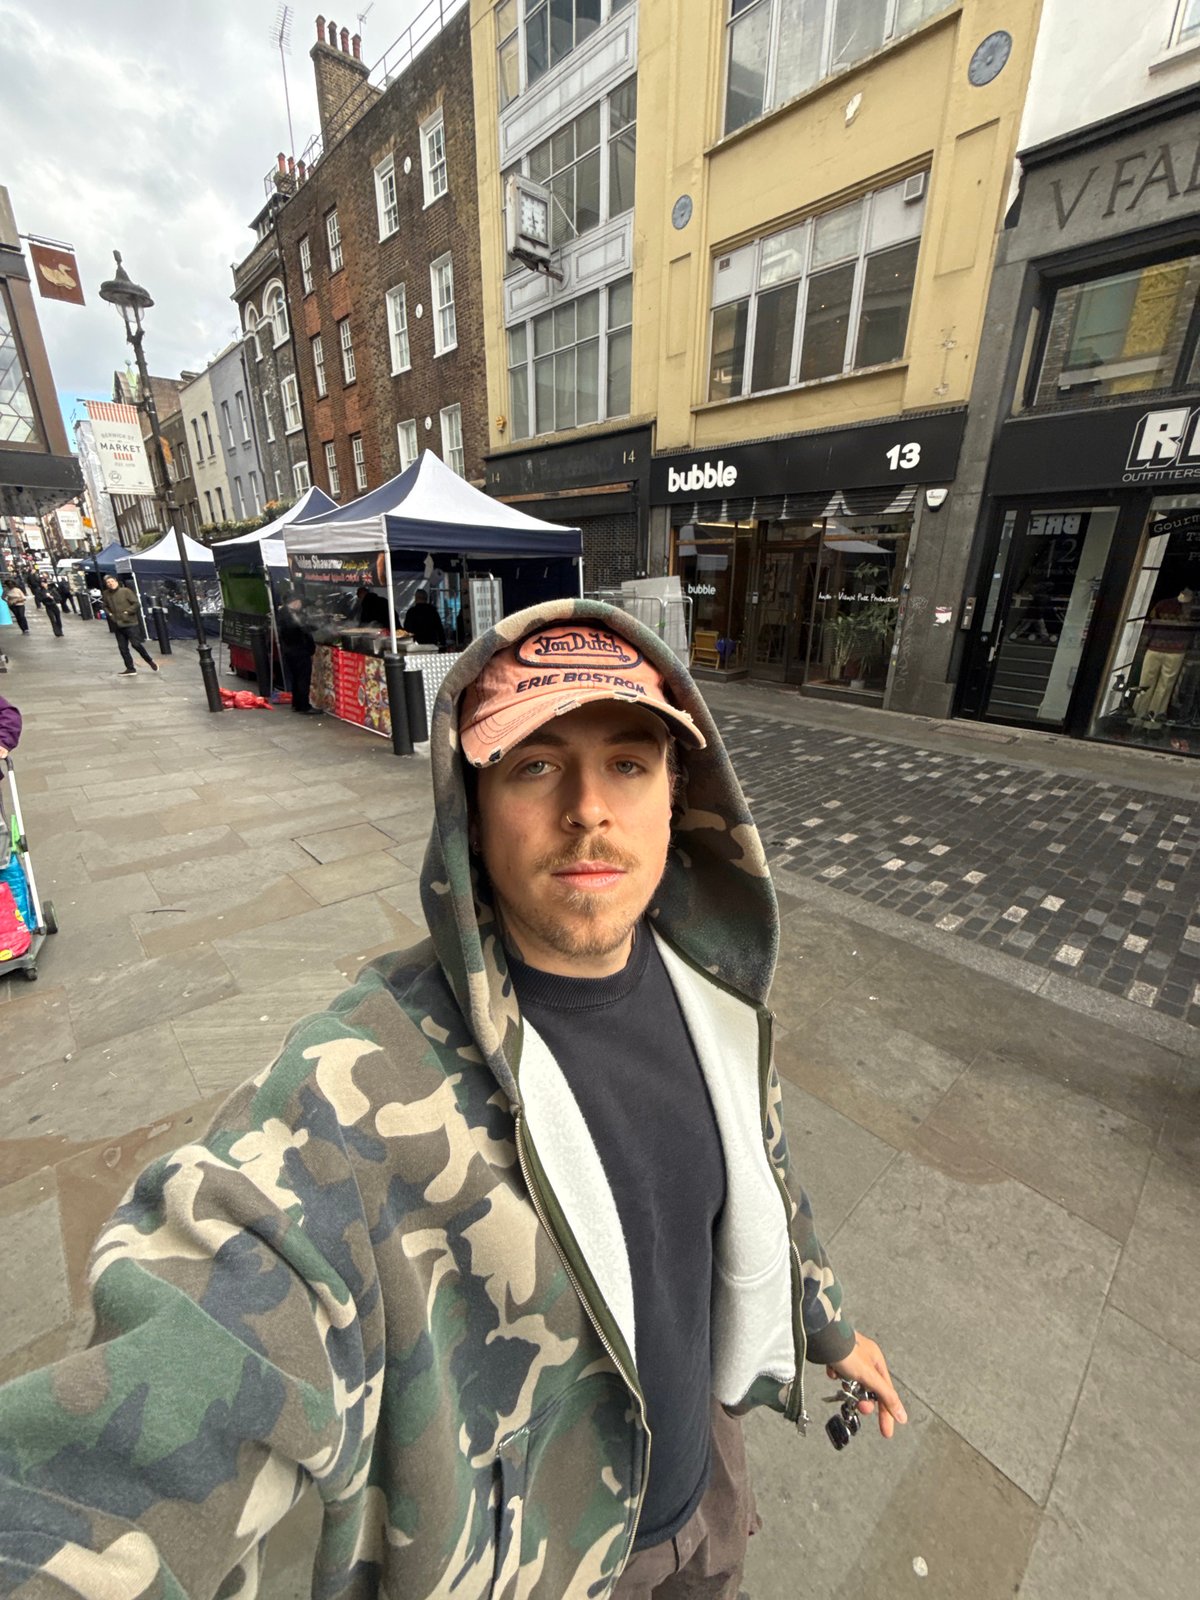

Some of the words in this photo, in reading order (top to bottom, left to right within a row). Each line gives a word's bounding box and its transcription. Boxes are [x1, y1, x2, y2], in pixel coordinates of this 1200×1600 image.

[1049, 165, 1100, 231] V
[100, 442, 141, 453] MARKET
[622, 449, 637, 465] 14
[886, 442, 922, 471] 13
[491, 472, 501, 484] 14
[668, 459, 738, 493] bubble
[687, 583, 717, 595] bubble
[516, 674, 560, 693] ERIC
